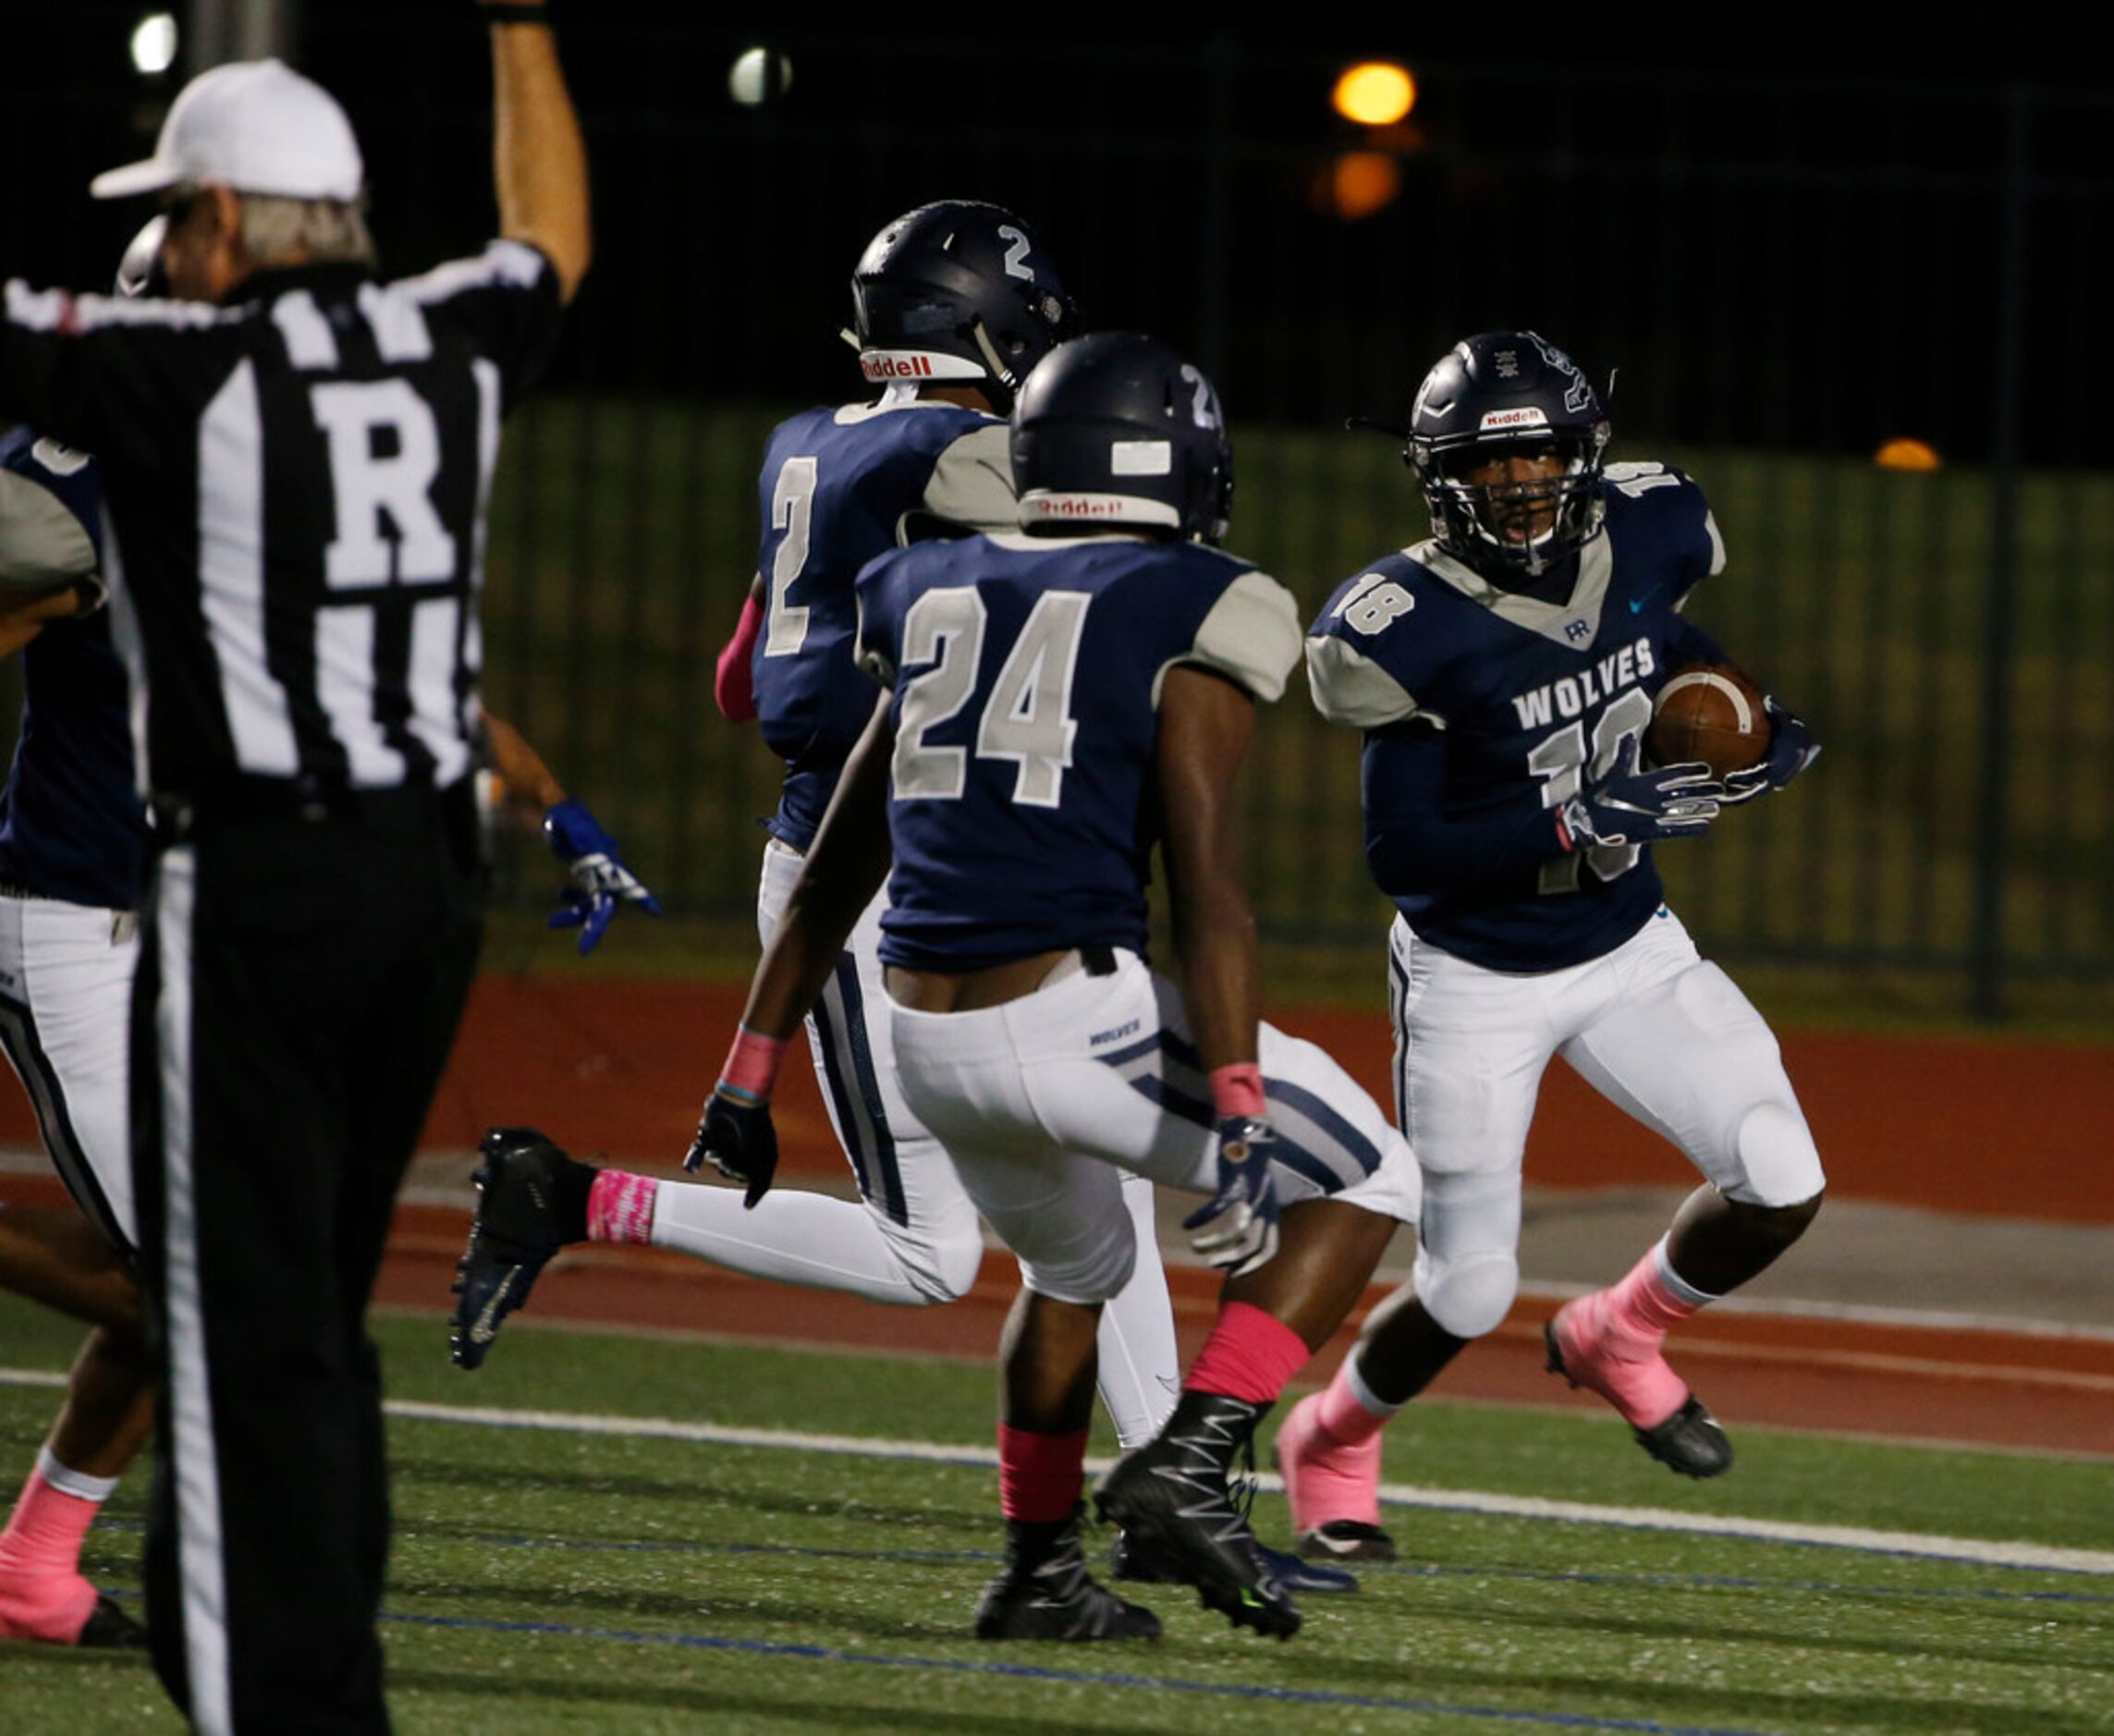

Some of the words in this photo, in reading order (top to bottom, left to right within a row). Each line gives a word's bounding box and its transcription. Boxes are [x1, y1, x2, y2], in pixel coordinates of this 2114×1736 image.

[998, 225, 1034, 283] 2
[310, 377, 457, 592] R
[764, 457, 818, 657] 2
[1329, 573, 1415, 635] 18
[892, 585, 1093, 808] 24
[1511, 637, 1655, 730] WOLVES
[1090, 1019, 1141, 1046] WOLVES
